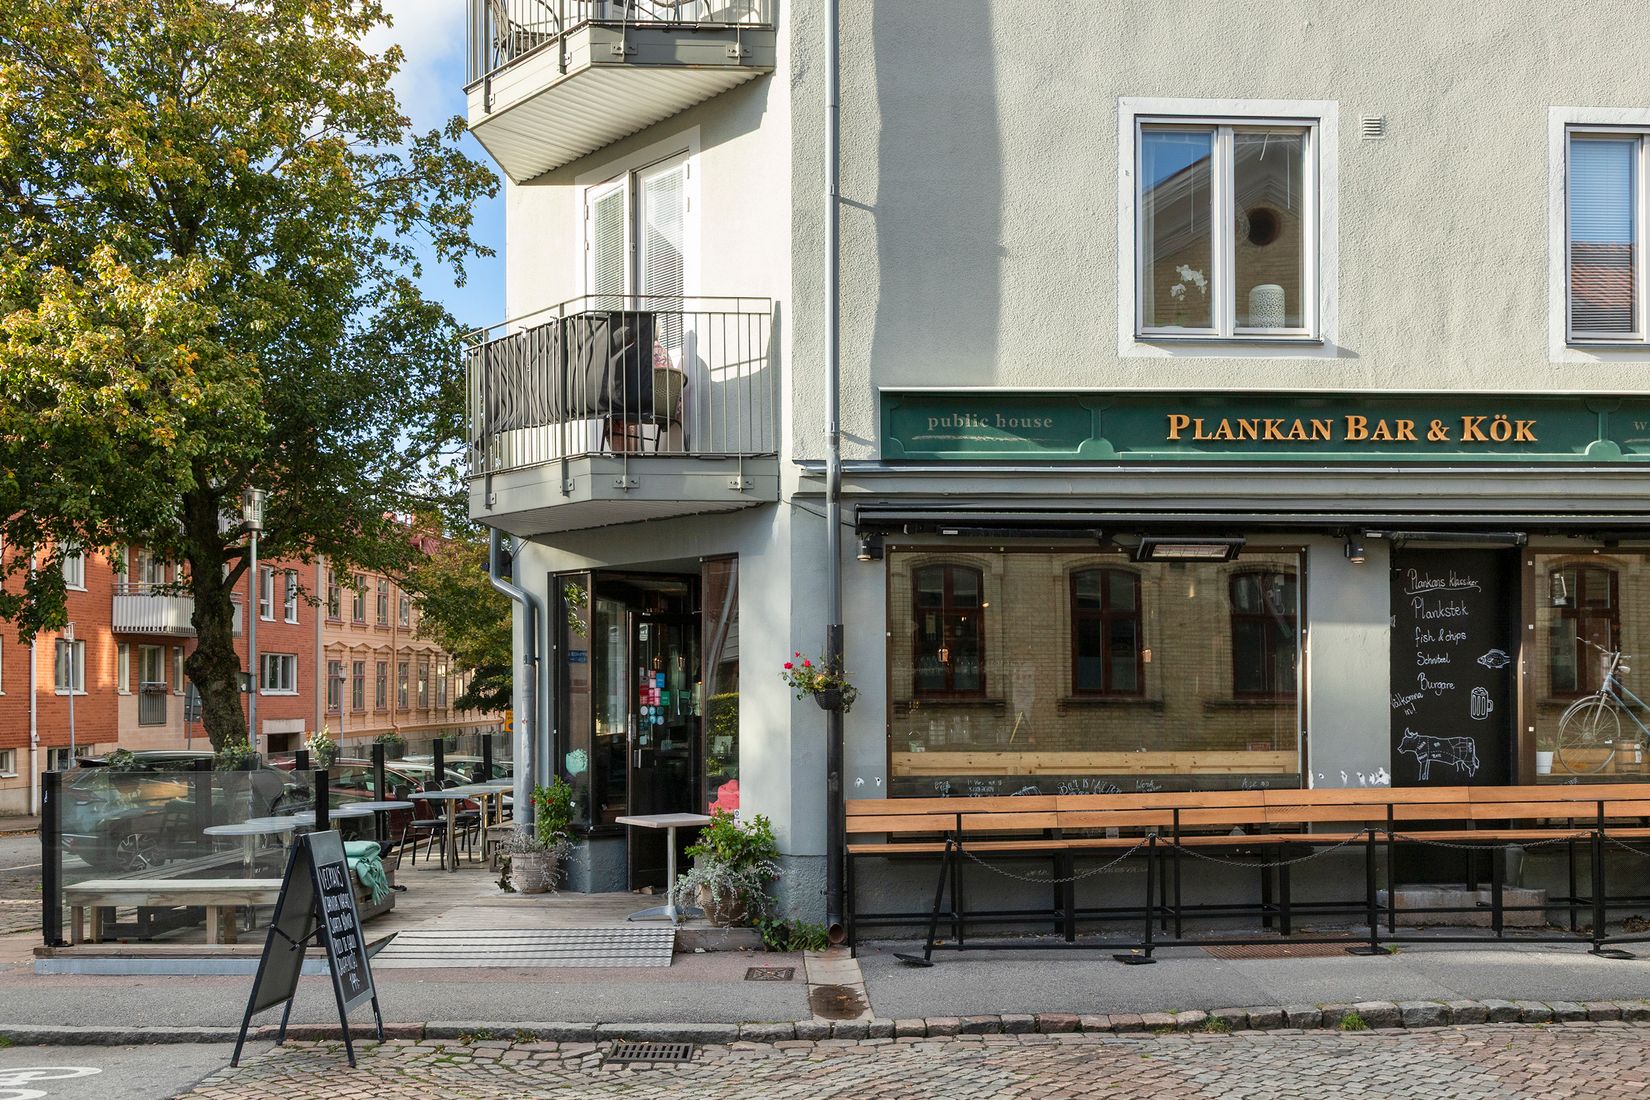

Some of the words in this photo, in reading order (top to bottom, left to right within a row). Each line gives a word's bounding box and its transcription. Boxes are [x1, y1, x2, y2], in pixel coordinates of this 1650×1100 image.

[927, 413, 989, 430] public
[995, 413, 1053, 428] house
[1166, 413, 1334, 441] PLANKAN
[1344, 415, 1418, 441] BAR
[1426, 419, 1450, 441] &
[1460, 414, 1538, 442] KÖK
[1407, 568, 1446, 590] Plankans
[1411, 596, 1469, 619] Plankstek
[1445, 630, 1467, 646] chips
[1417, 672, 1455, 696] Burgare
